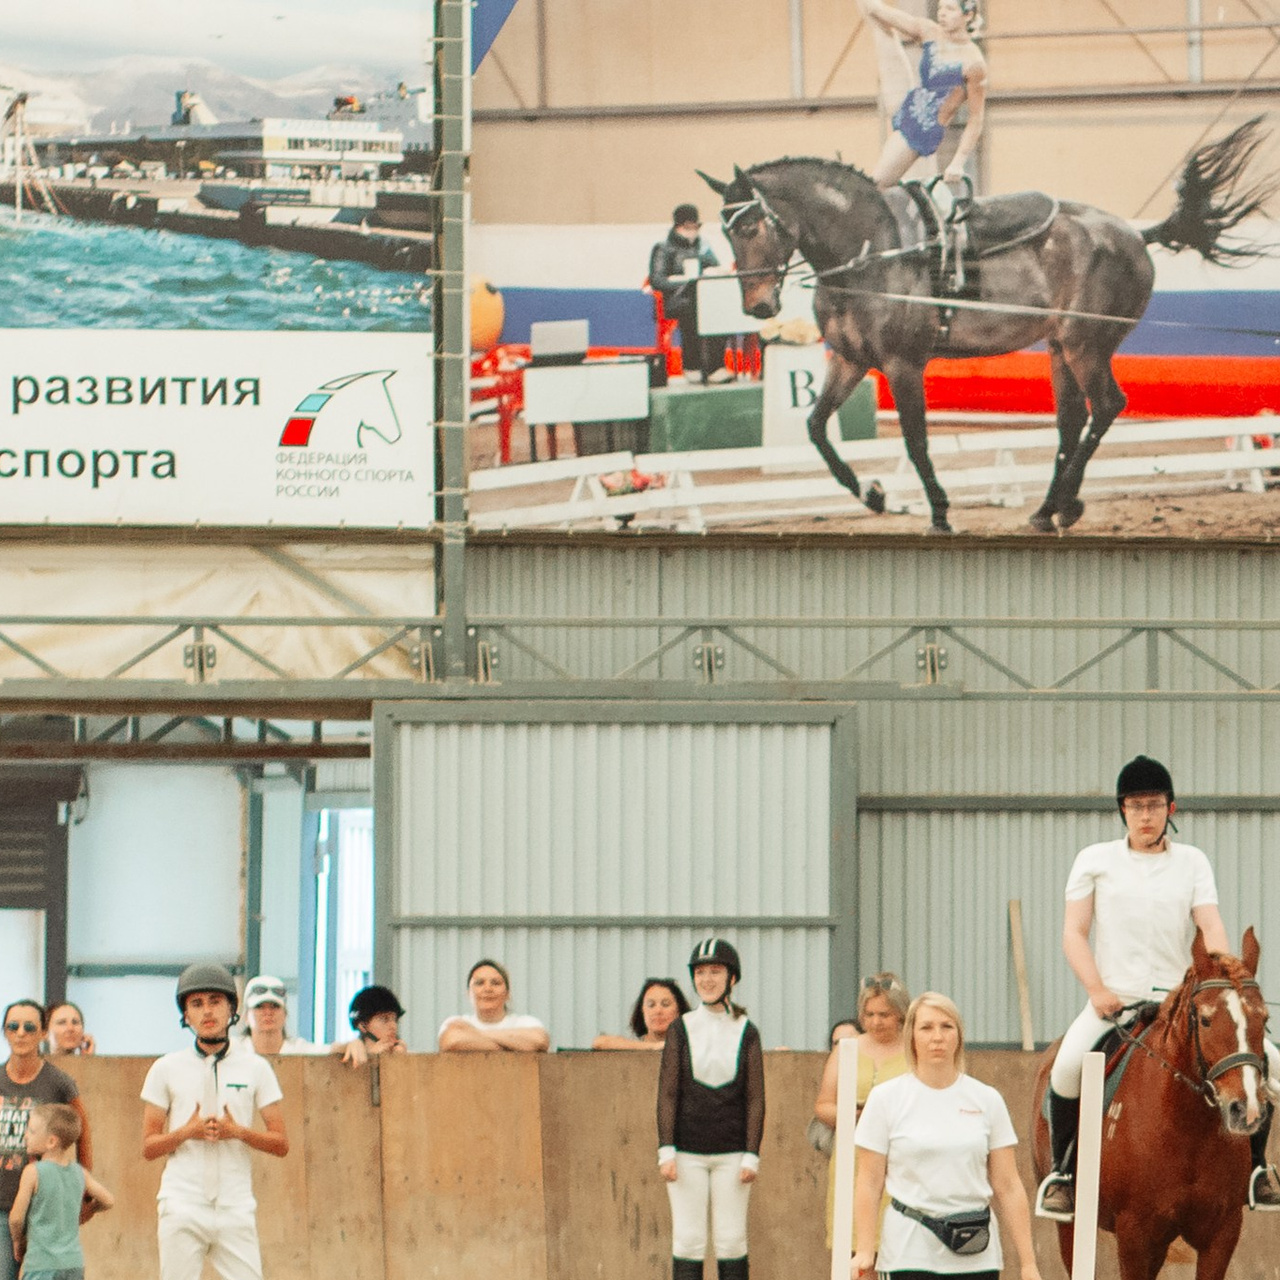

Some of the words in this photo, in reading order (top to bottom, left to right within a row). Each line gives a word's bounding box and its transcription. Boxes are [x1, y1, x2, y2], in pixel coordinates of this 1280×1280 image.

[12, 375, 260, 414] развития
[275, 451, 368, 466] ФЕДЕРАЦИЯ
[0, 448, 177, 488] спорта
[275, 468, 351, 482] КОННОГО
[354, 468, 415, 482] СПОРТА
[275, 484, 341, 498] РОССИИ
